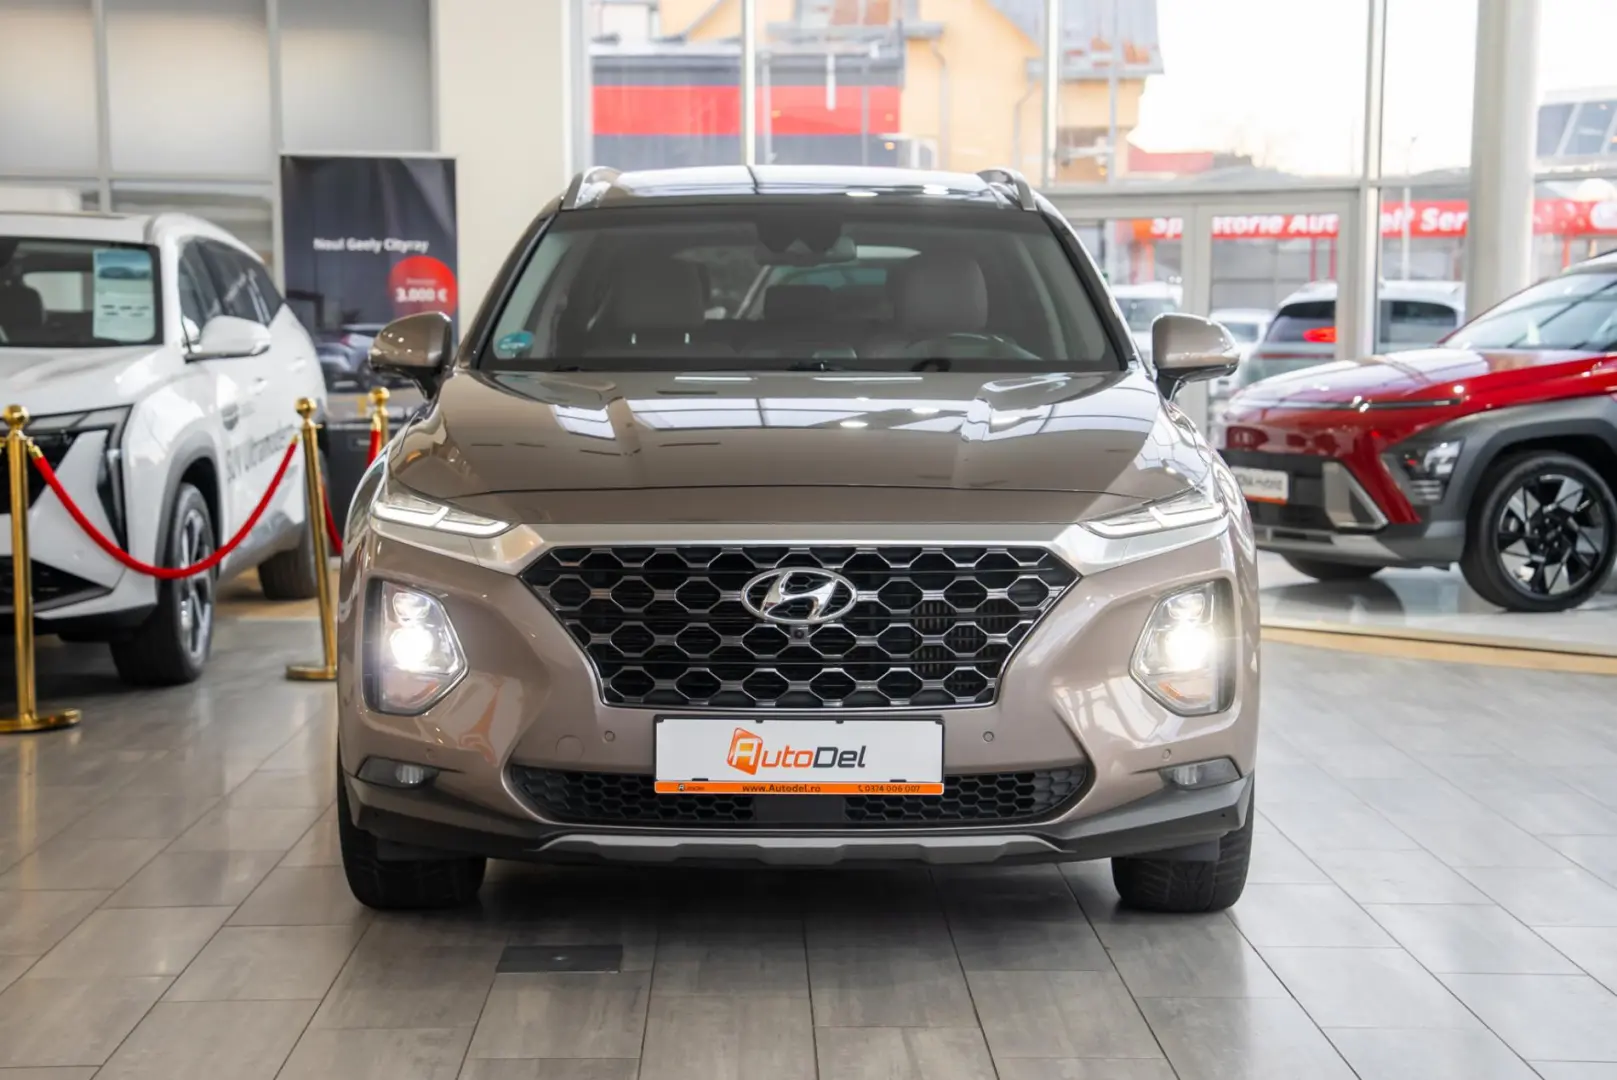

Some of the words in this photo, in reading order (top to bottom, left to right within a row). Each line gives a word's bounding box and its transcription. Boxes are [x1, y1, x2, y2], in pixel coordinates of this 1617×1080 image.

[1288, 214, 1339, 235] Aut
[729, 732, 867, 772] AutoDel
[742, 784, 821, 793] www.Autodel.ro
[864, 785, 884, 793] 0374
